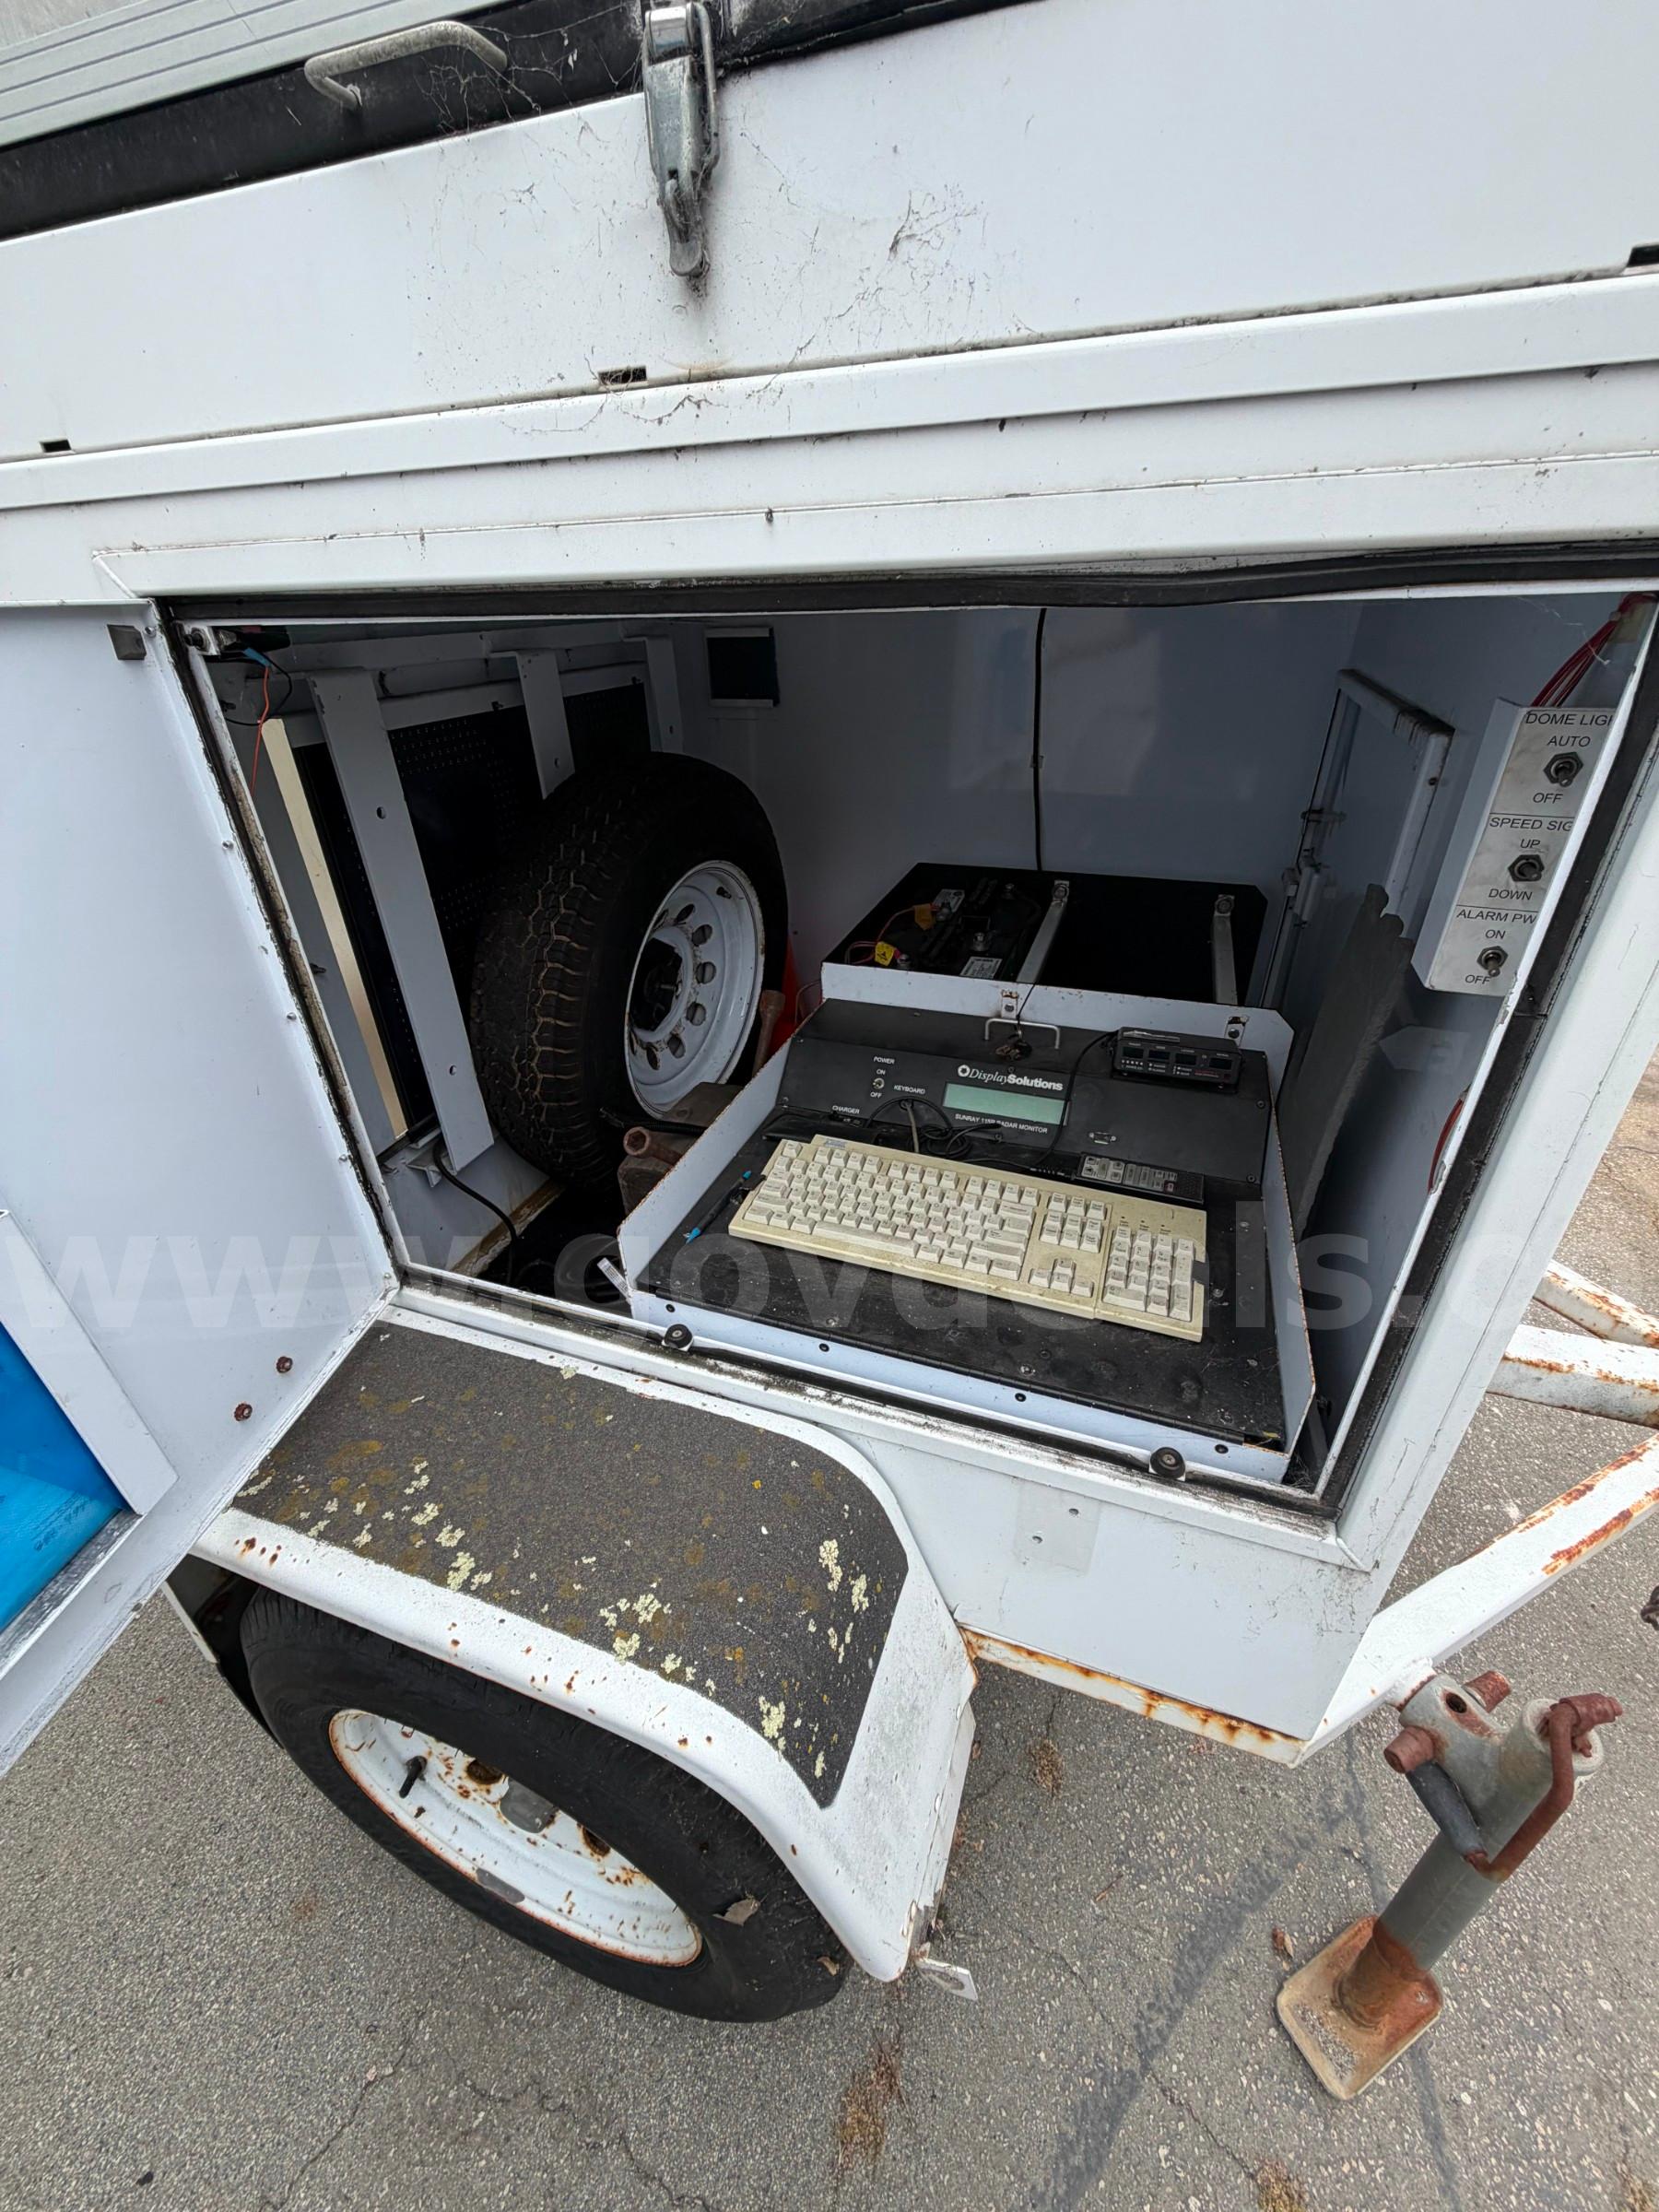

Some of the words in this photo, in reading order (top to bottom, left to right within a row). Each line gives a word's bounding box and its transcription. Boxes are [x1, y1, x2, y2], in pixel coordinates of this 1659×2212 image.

[1525, 712, 1576, 726] DOME
[1547, 735, 1591, 747] AUTO
[1533, 793, 1563, 805] OFF
[1489, 817, 1543, 830] SPEED
[1521, 839, 1540, 848] UP
[1488, 888, 1532, 900] DOWN
[1456, 909, 1508, 922] ALARM
[1485, 929, 1506, 939] ON
[1465, 974, 1490, 985] OFF
[873, 1055, 895, 1065] POWER
[969, 1068, 1064, 1091] DisplaySolutions
[893, 1084, 925, 1095] KEYBOARD
[831, 1105, 860, 1114] CHARGER
[954, 1112, 980, 1124] SUNRAY
[1018, 1123, 1048, 1135] MONITOR
